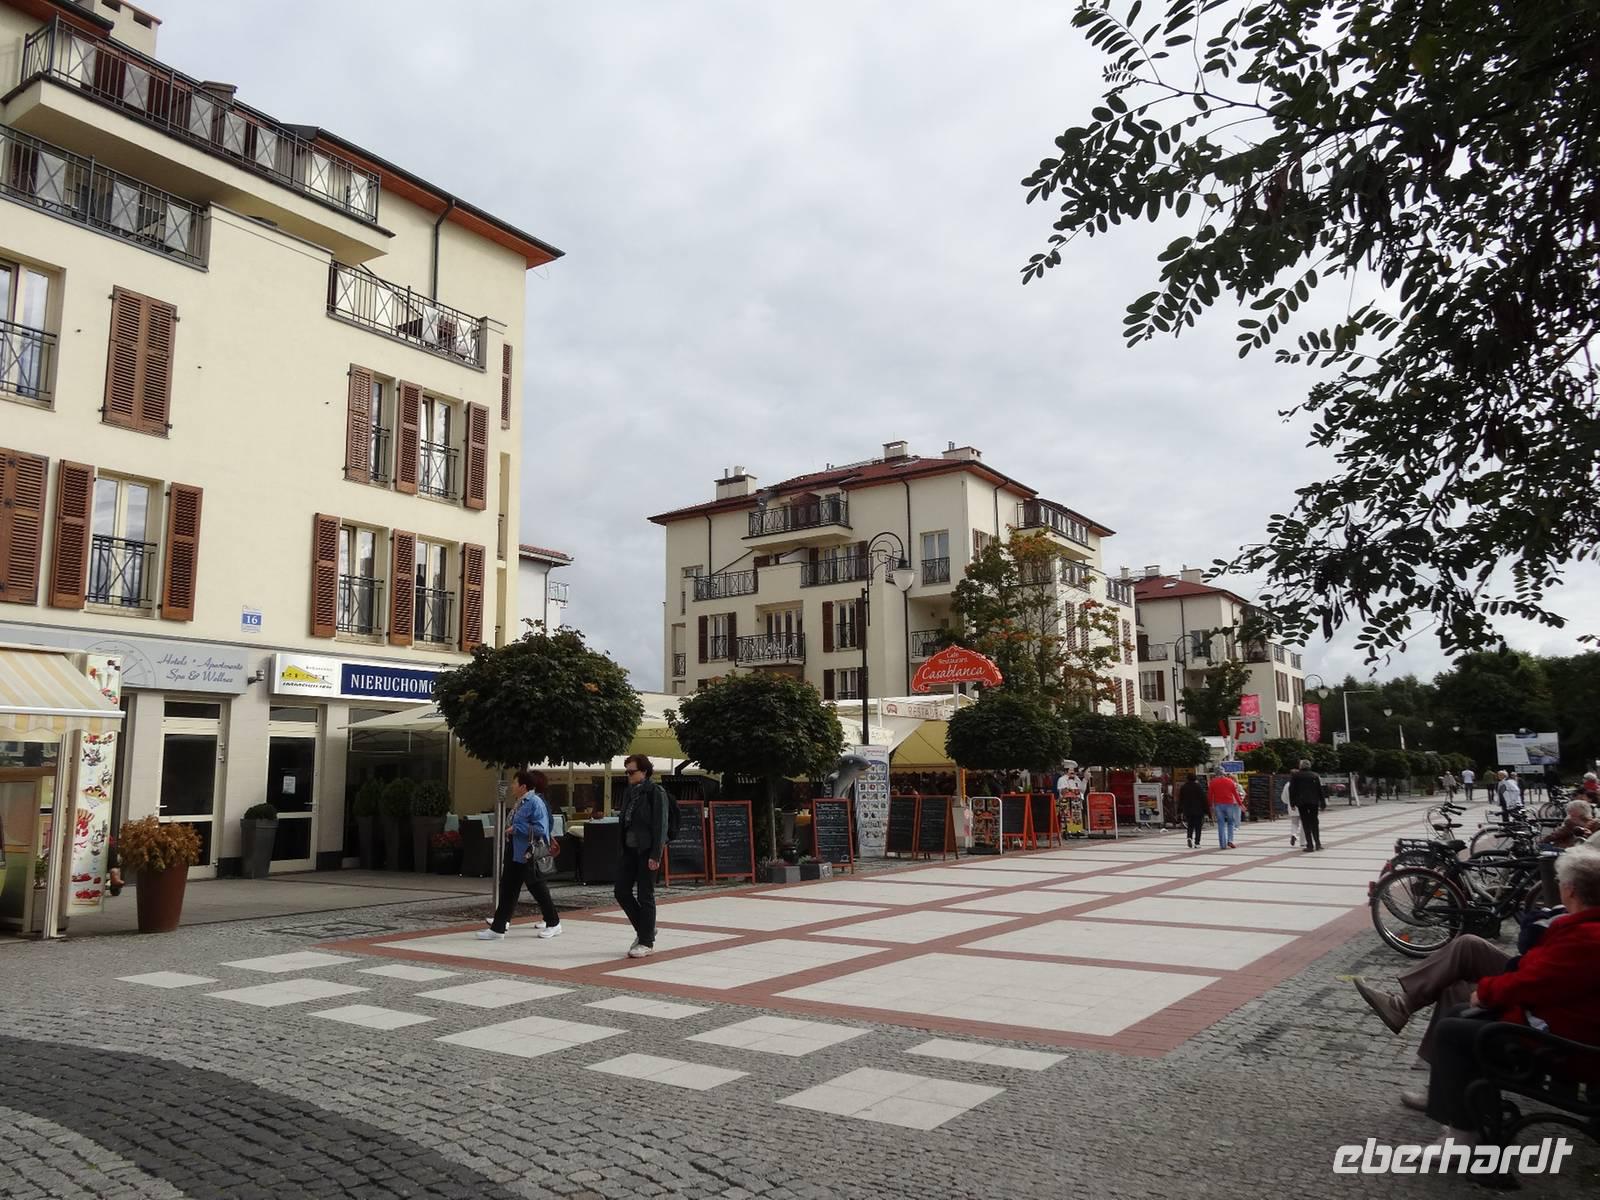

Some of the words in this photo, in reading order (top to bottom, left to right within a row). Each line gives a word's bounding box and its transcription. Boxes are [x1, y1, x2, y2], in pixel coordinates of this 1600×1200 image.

[246, 615, 258, 625] 16
[156, 653, 188, 666] Hotels
[197, 656, 243, 670] Apartments
[166, 668, 185, 682] Spa
[921, 664, 985, 680] Casablanca
